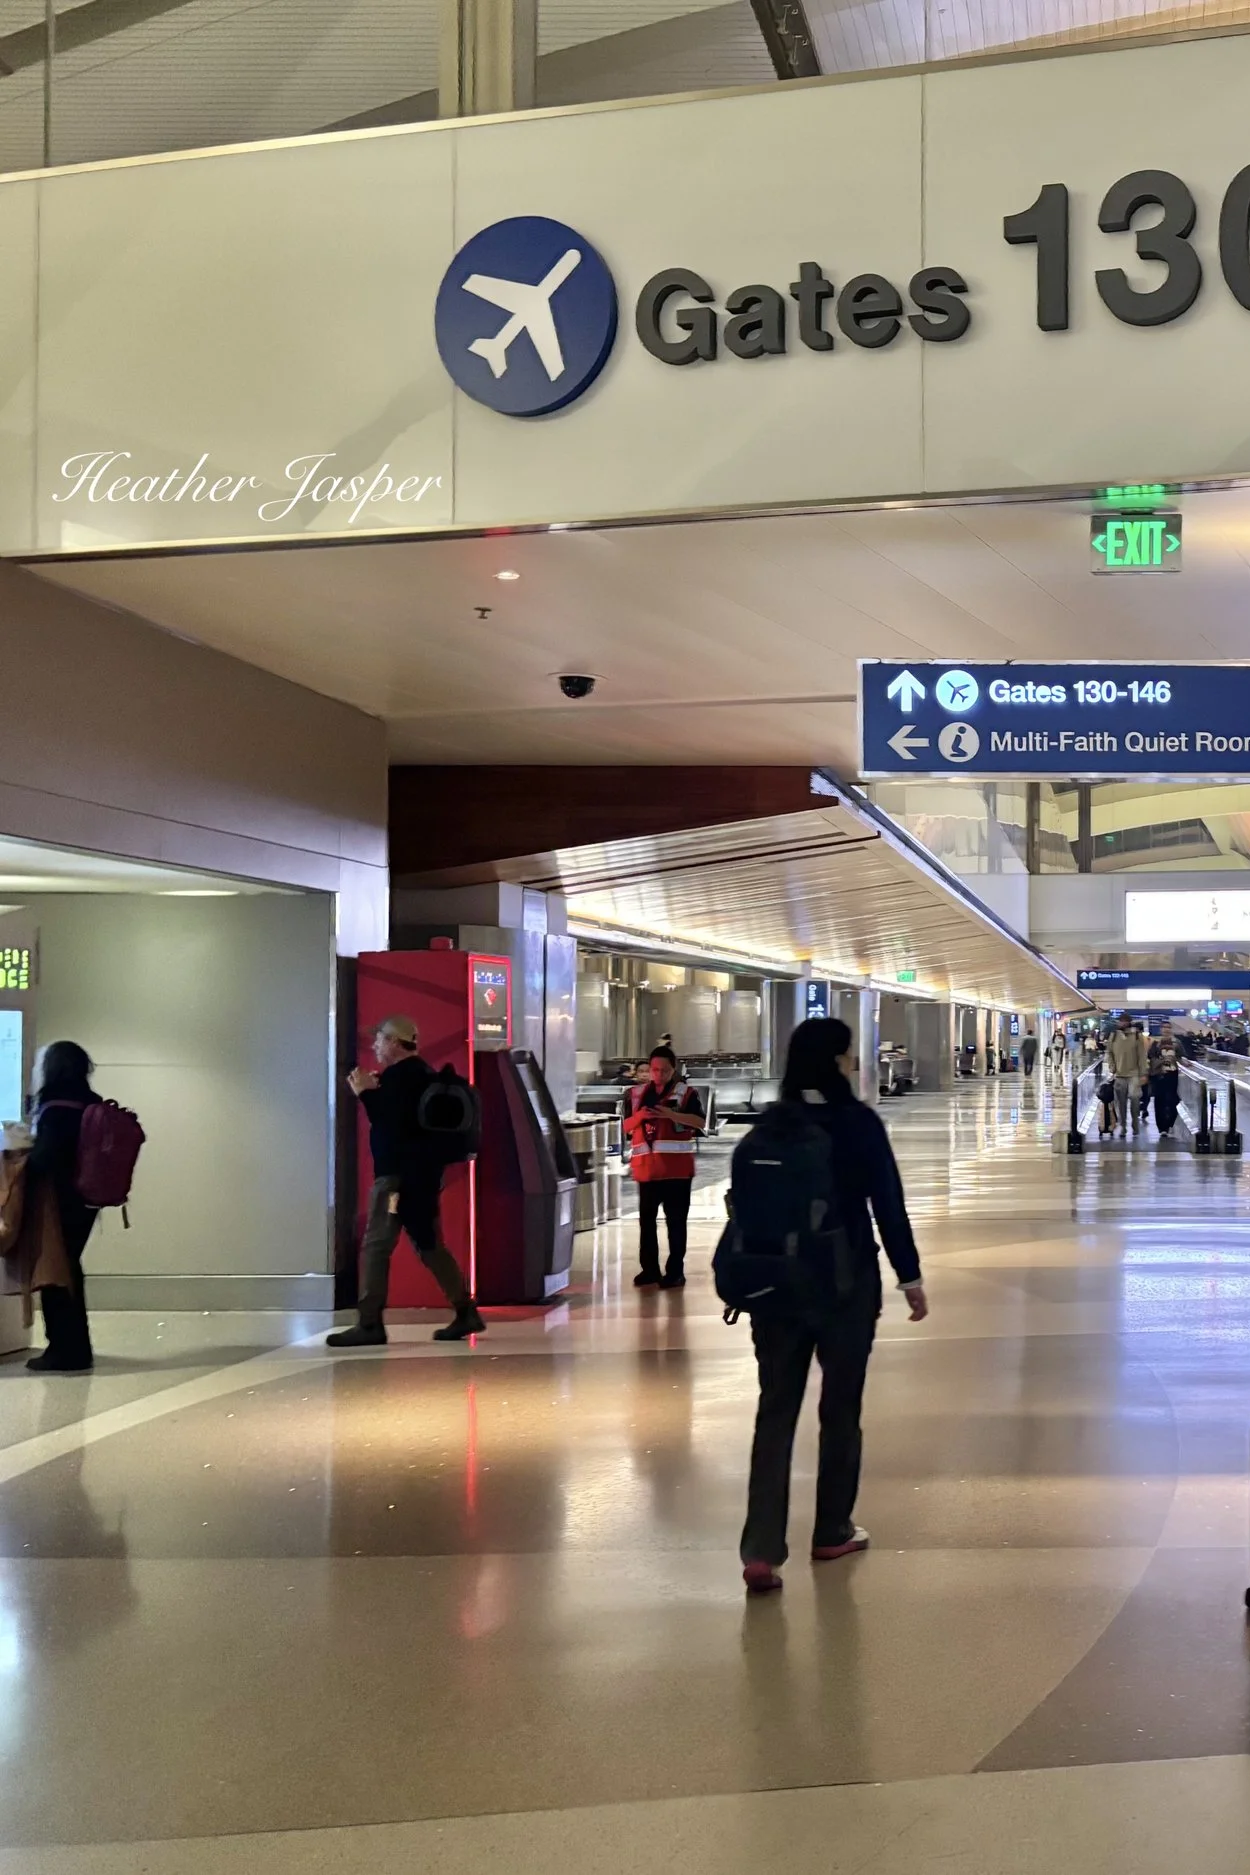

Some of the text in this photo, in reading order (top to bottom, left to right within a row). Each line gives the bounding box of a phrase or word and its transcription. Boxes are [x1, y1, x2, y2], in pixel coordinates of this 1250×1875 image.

[635, 261, 971, 366] Gates
[1106, 521, 1167, 565] EXIT
[988, 680, 1172, 704] Gates 130-146
[989, 730, 1118, 754] Multi-Faith
[1125, 731, 1189, 755] Quiet
[808, 984, 824, 1019] Gate 13
